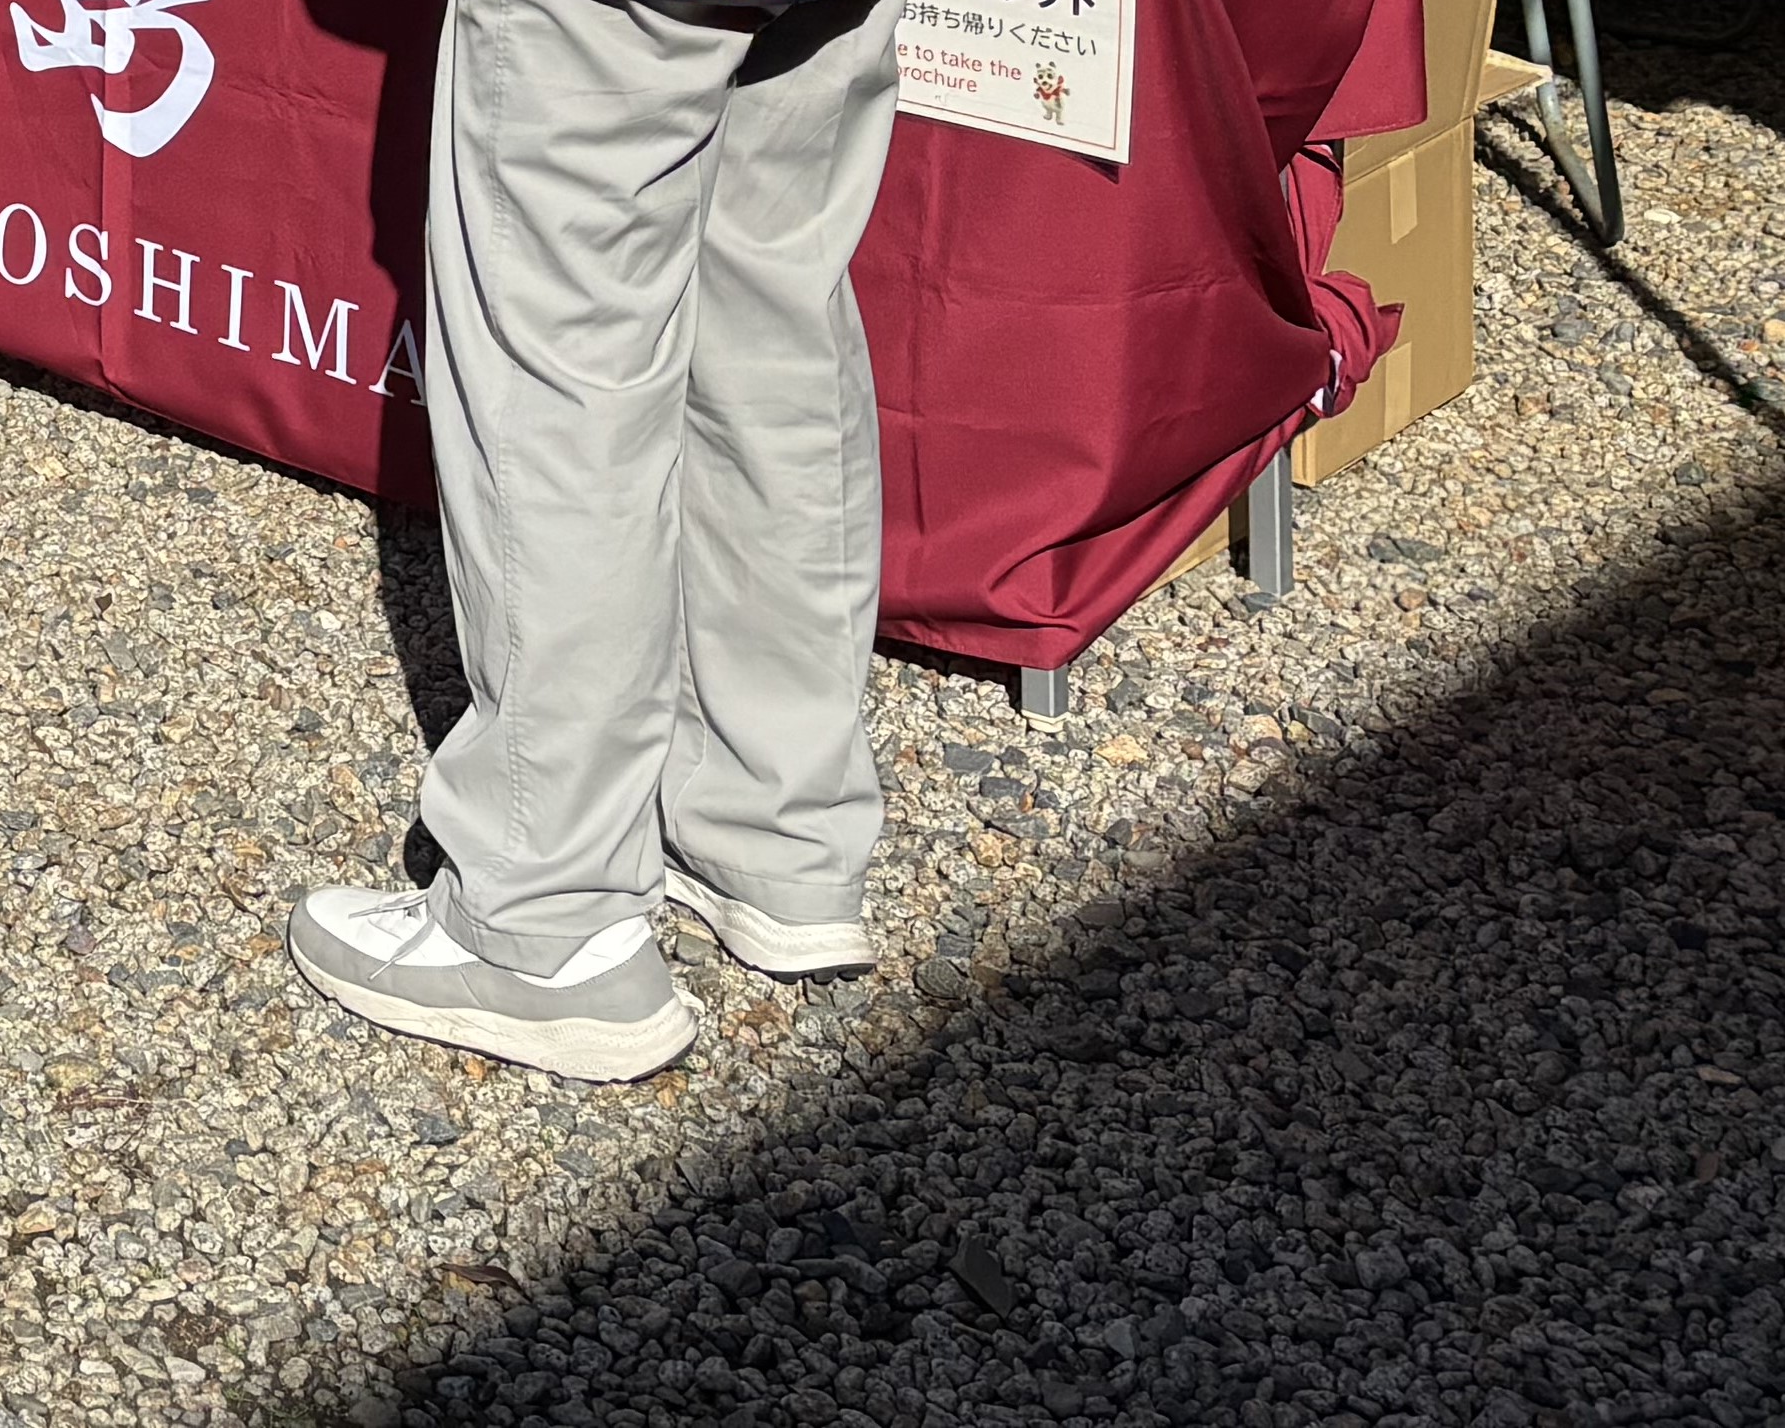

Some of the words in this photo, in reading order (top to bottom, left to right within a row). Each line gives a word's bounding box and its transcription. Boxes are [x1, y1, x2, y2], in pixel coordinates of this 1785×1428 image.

[915, 44, 935, 62] to
[941, 51, 983, 73] take
[990, 60, 1022, 81] the
